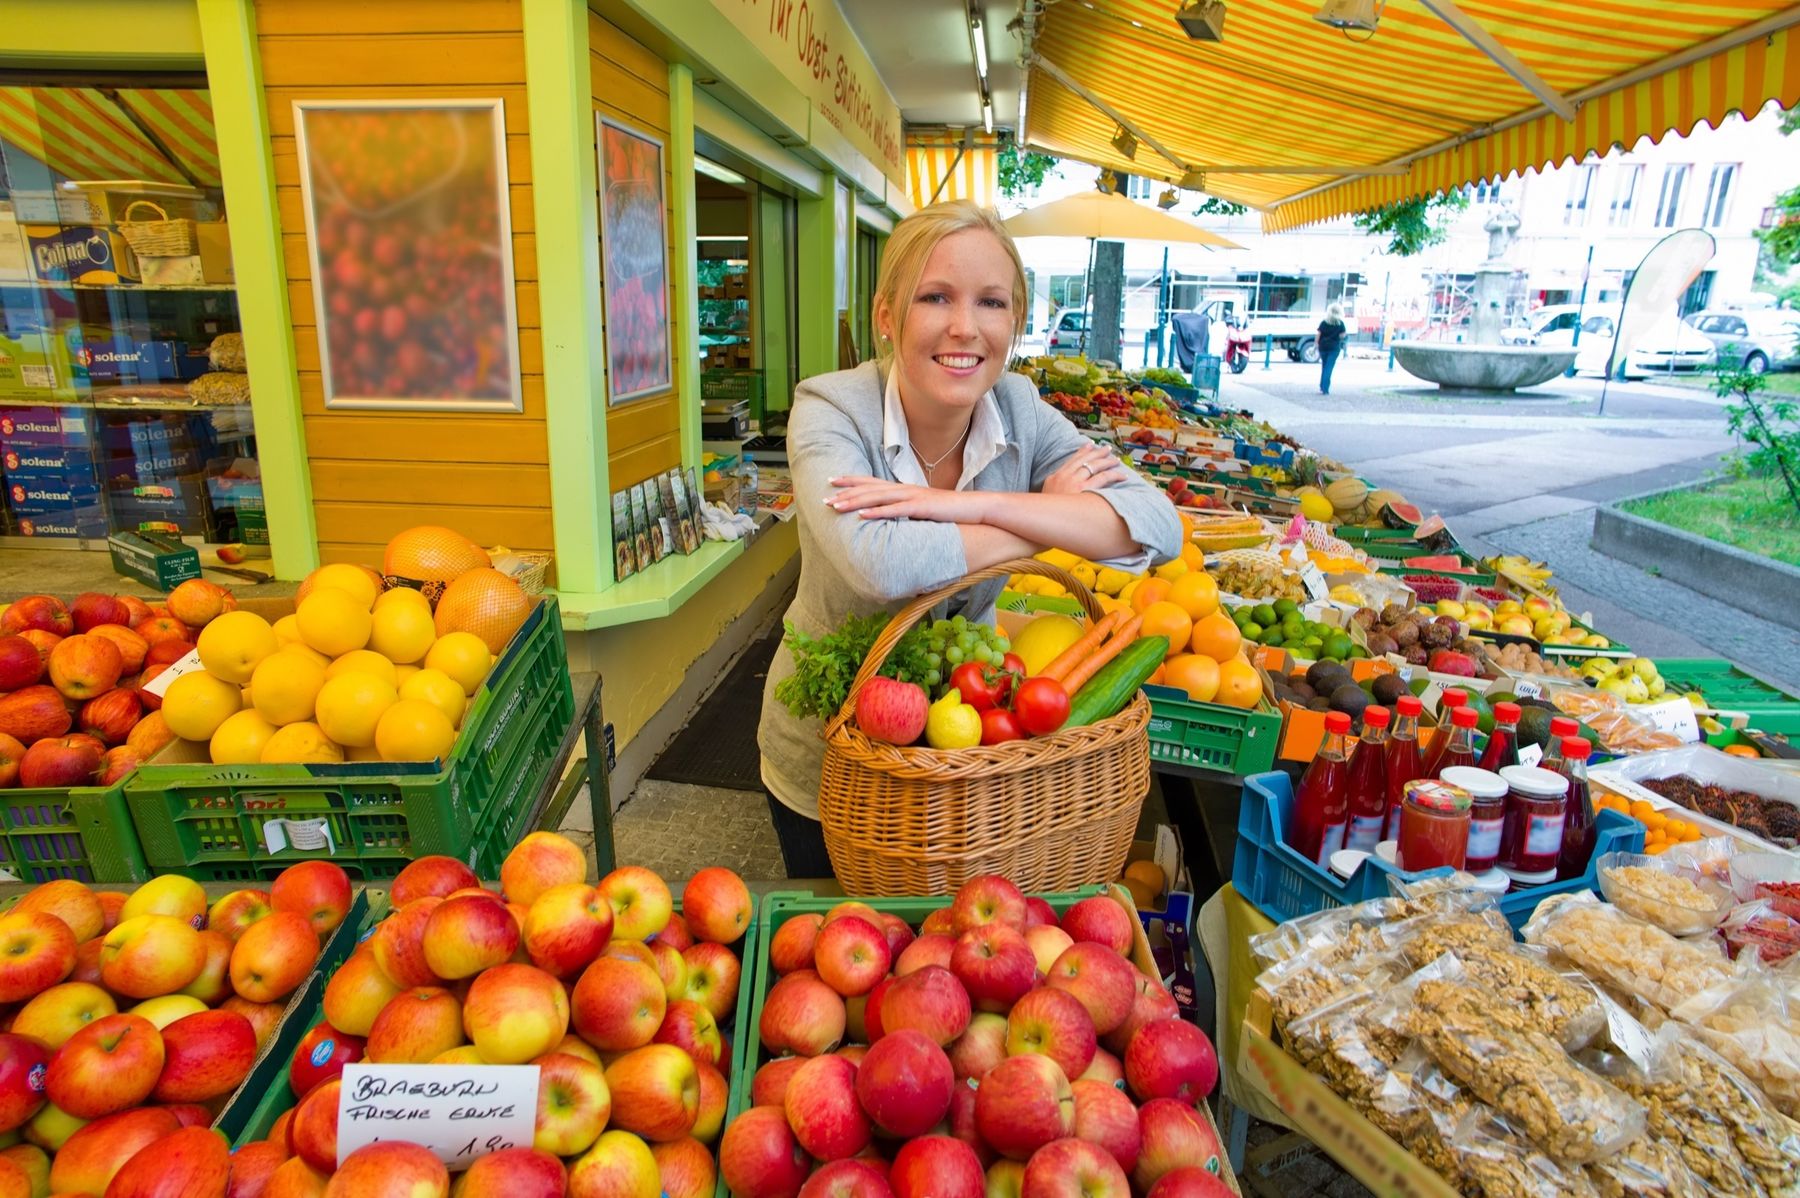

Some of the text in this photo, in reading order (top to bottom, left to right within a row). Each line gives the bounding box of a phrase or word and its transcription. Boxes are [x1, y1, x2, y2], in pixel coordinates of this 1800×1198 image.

[95, 352, 140, 362] solena
[16, 422, 59, 433] solena
[21, 457, 63, 467] solena
[28, 490, 70, 500] solena
[36, 524, 77, 534] solena
[352, 1074, 498, 1101] BRAEBURN
[346, 1104, 515, 1121] FRISCHE ERNTE
